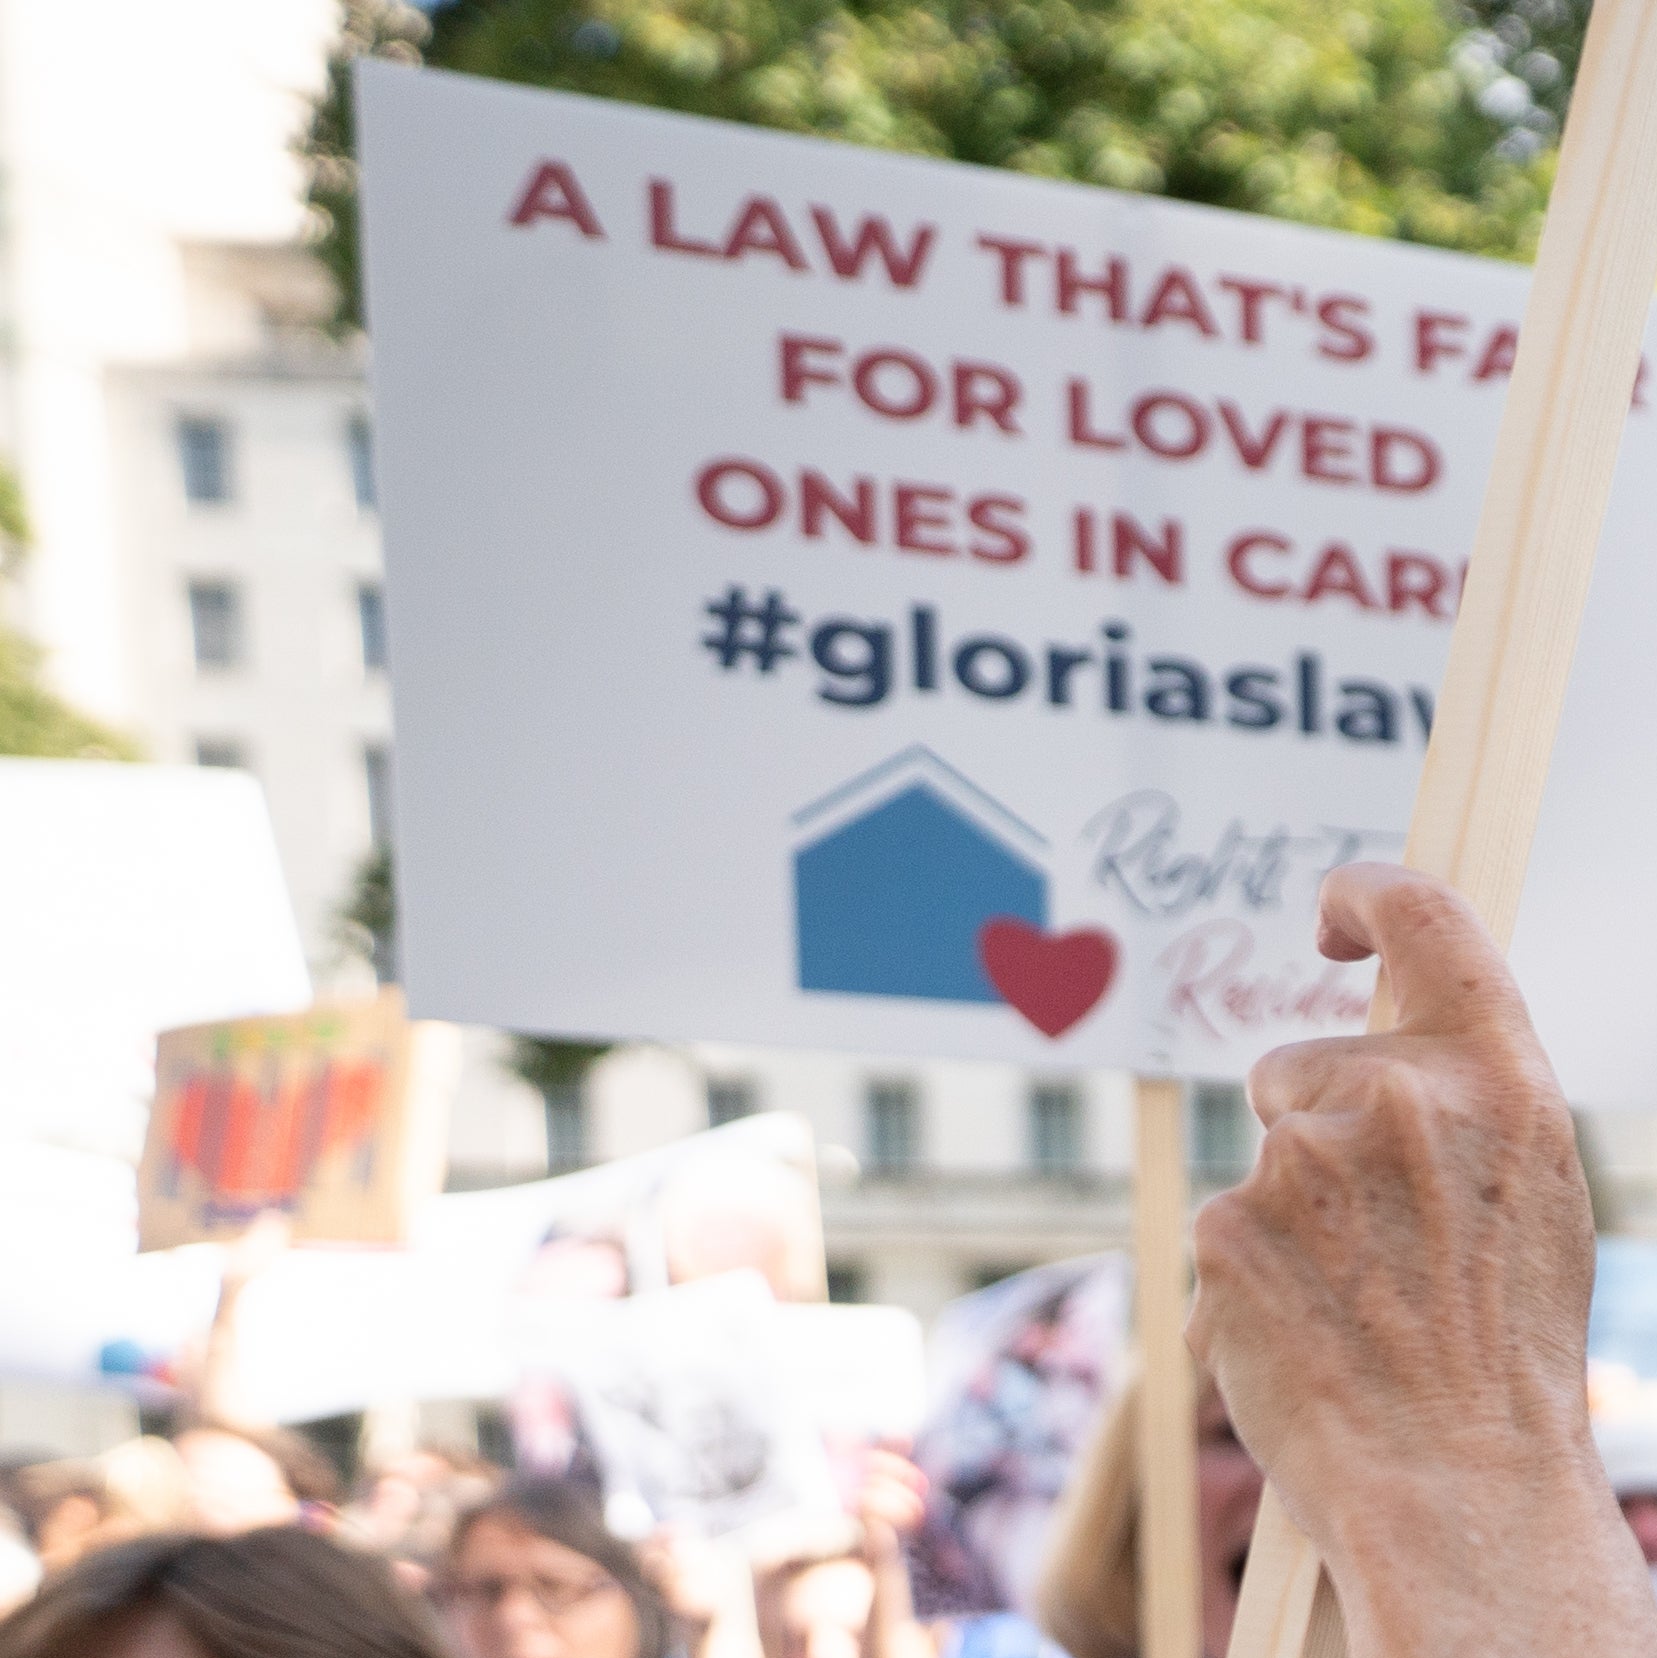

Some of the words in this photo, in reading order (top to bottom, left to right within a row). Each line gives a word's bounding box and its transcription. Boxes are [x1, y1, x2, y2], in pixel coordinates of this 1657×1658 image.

[505, 158, 605, 241] A
[644, 178, 936, 291] LAW
[973, 231, 1377, 365] THAT'S
[774, 331, 1024, 436] FOR
[1062, 375, 1444, 497] LOVED
[690, 456, 1032, 567] ONES
[1070, 506, 1185, 587] IN
[1221, 529, 1470, 621] CAR
